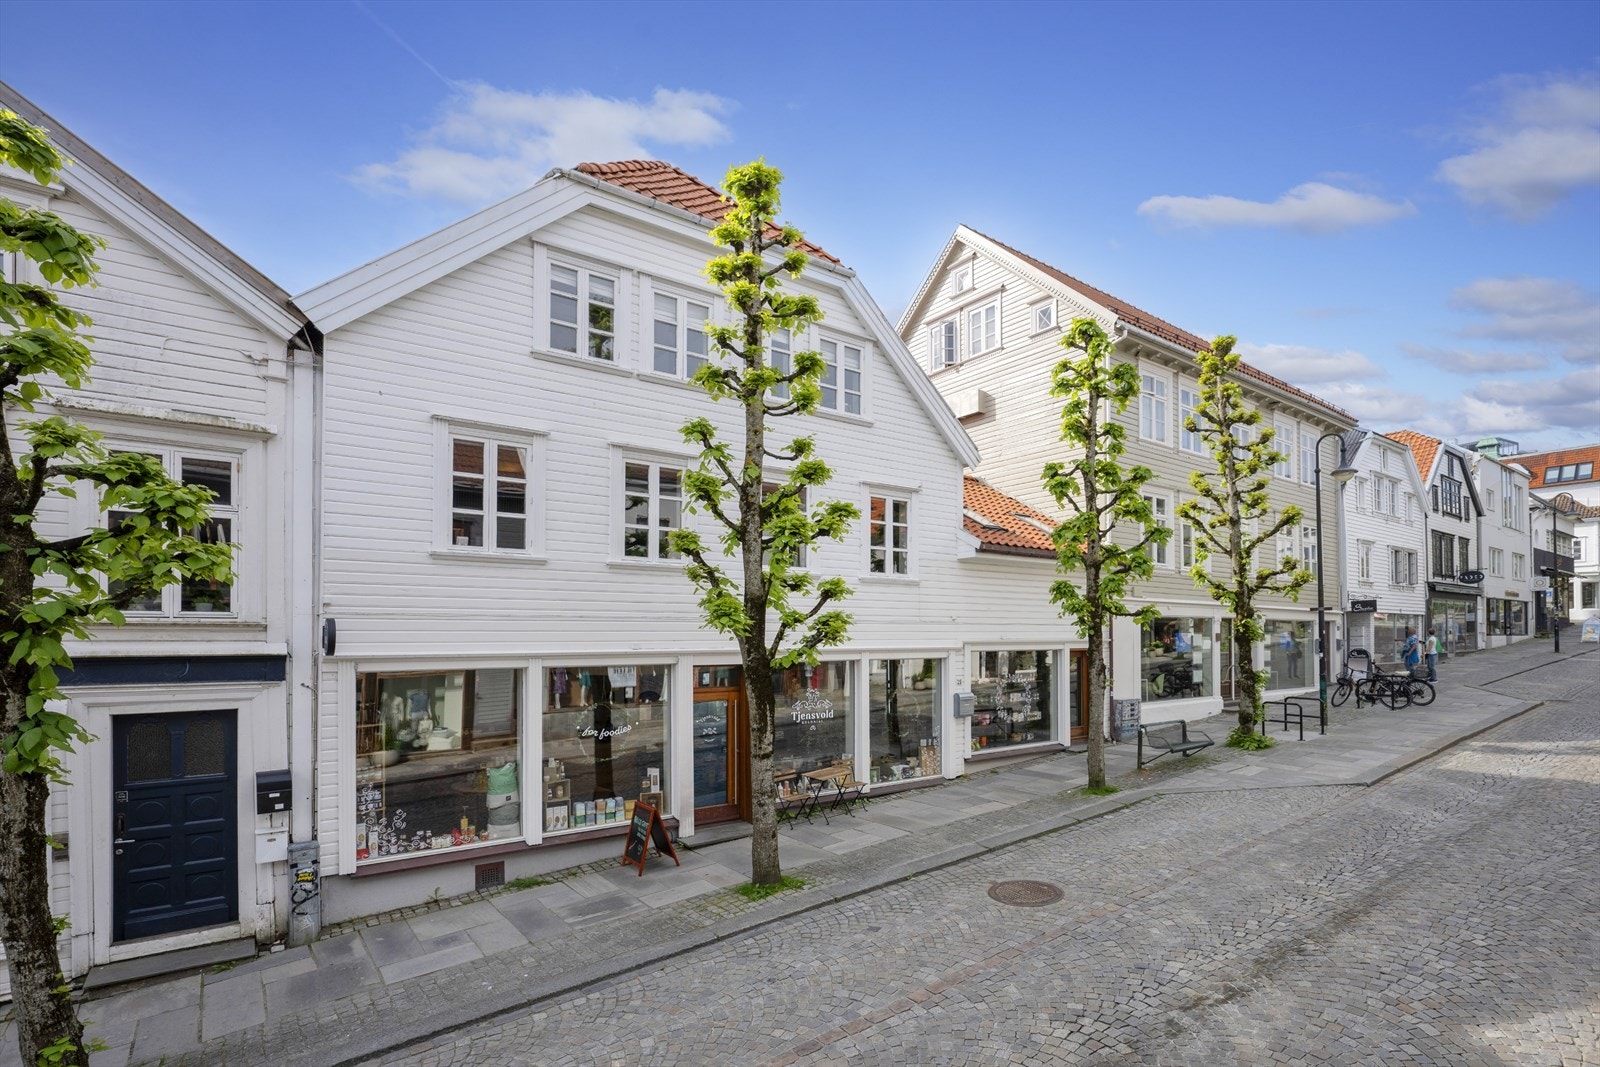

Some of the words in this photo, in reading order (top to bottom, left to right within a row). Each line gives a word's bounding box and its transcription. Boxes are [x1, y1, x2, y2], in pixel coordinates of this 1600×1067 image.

[791, 709, 834, 723] Tjensvold
[582, 726, 599, 737] for
[598, 724, 632, 740] foodies
